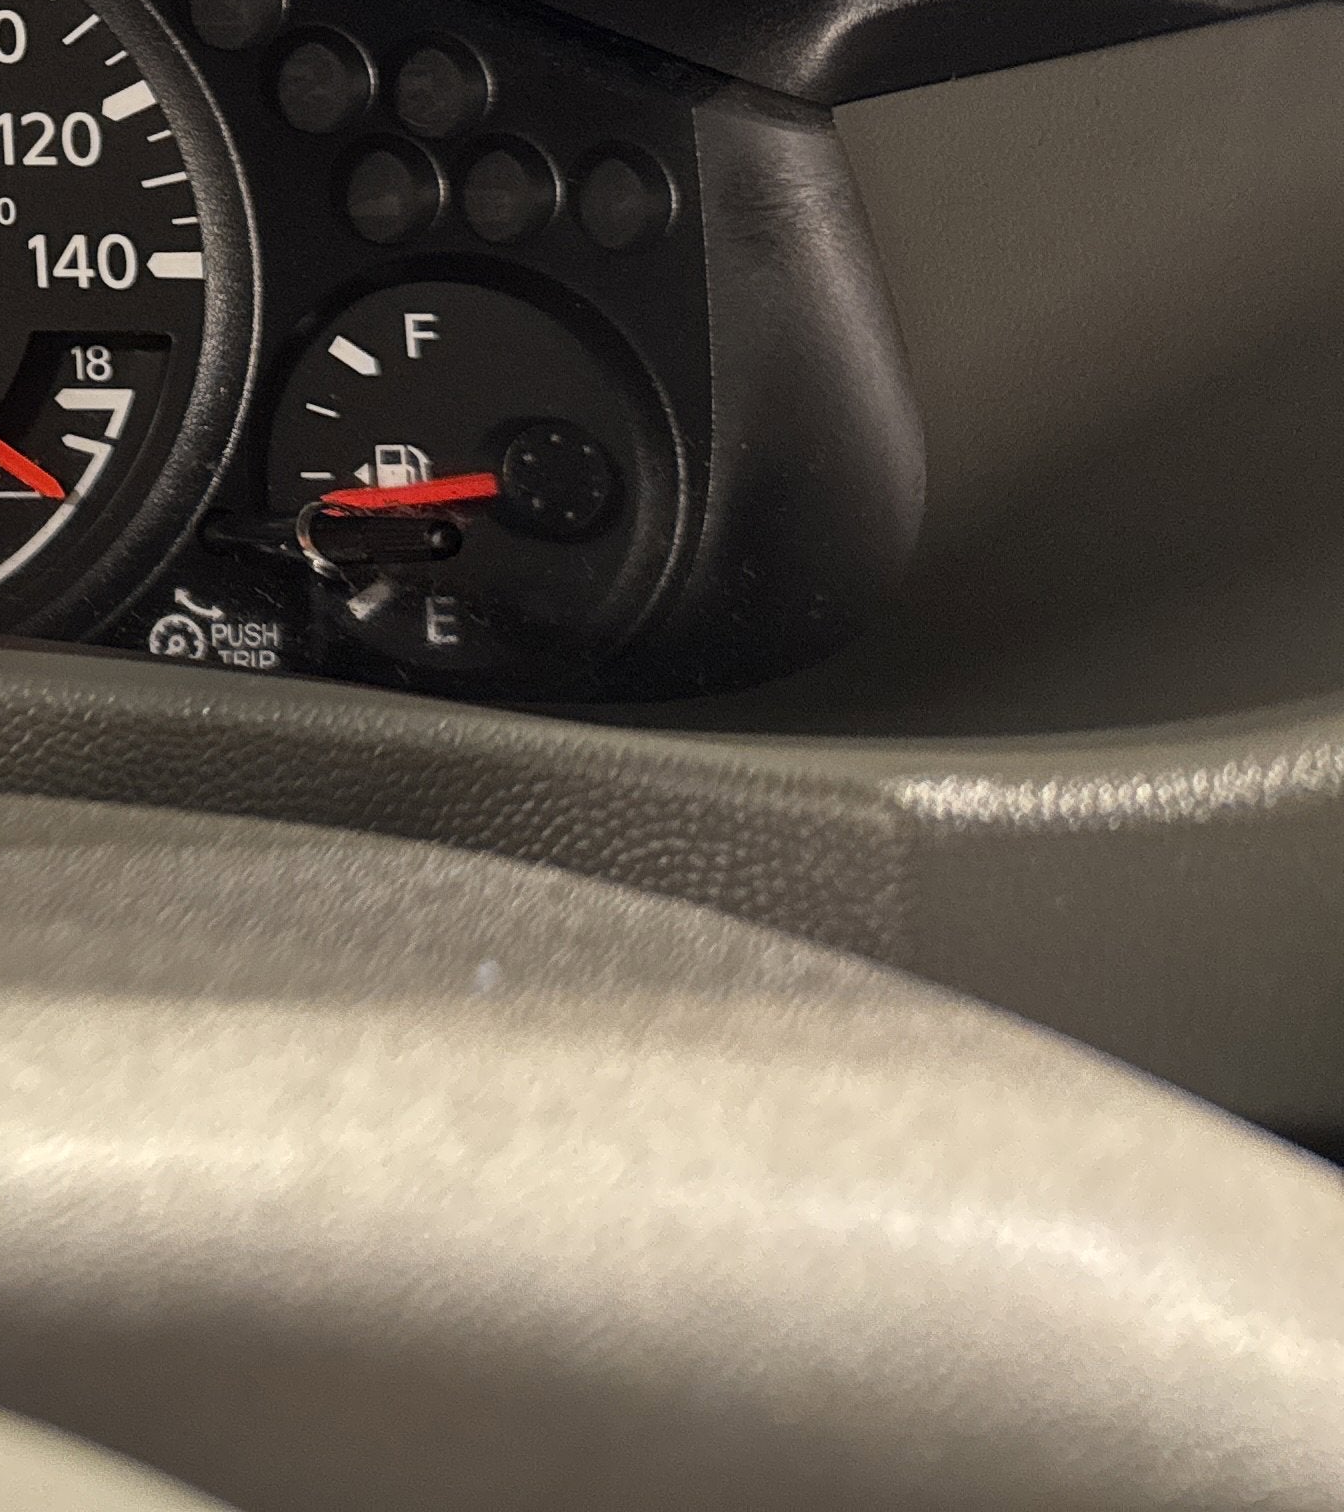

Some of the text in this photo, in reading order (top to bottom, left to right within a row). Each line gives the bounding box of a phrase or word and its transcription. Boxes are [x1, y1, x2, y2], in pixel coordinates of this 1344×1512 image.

[28, 233, 137, 290] 140
[404, 313, 437, 359] F
[71, 346, 113, 382] 18
[210, 622, 279, 648] PUSH
[425, 595, 459, 645] E
[217, 650, 277, 670] TRIP
